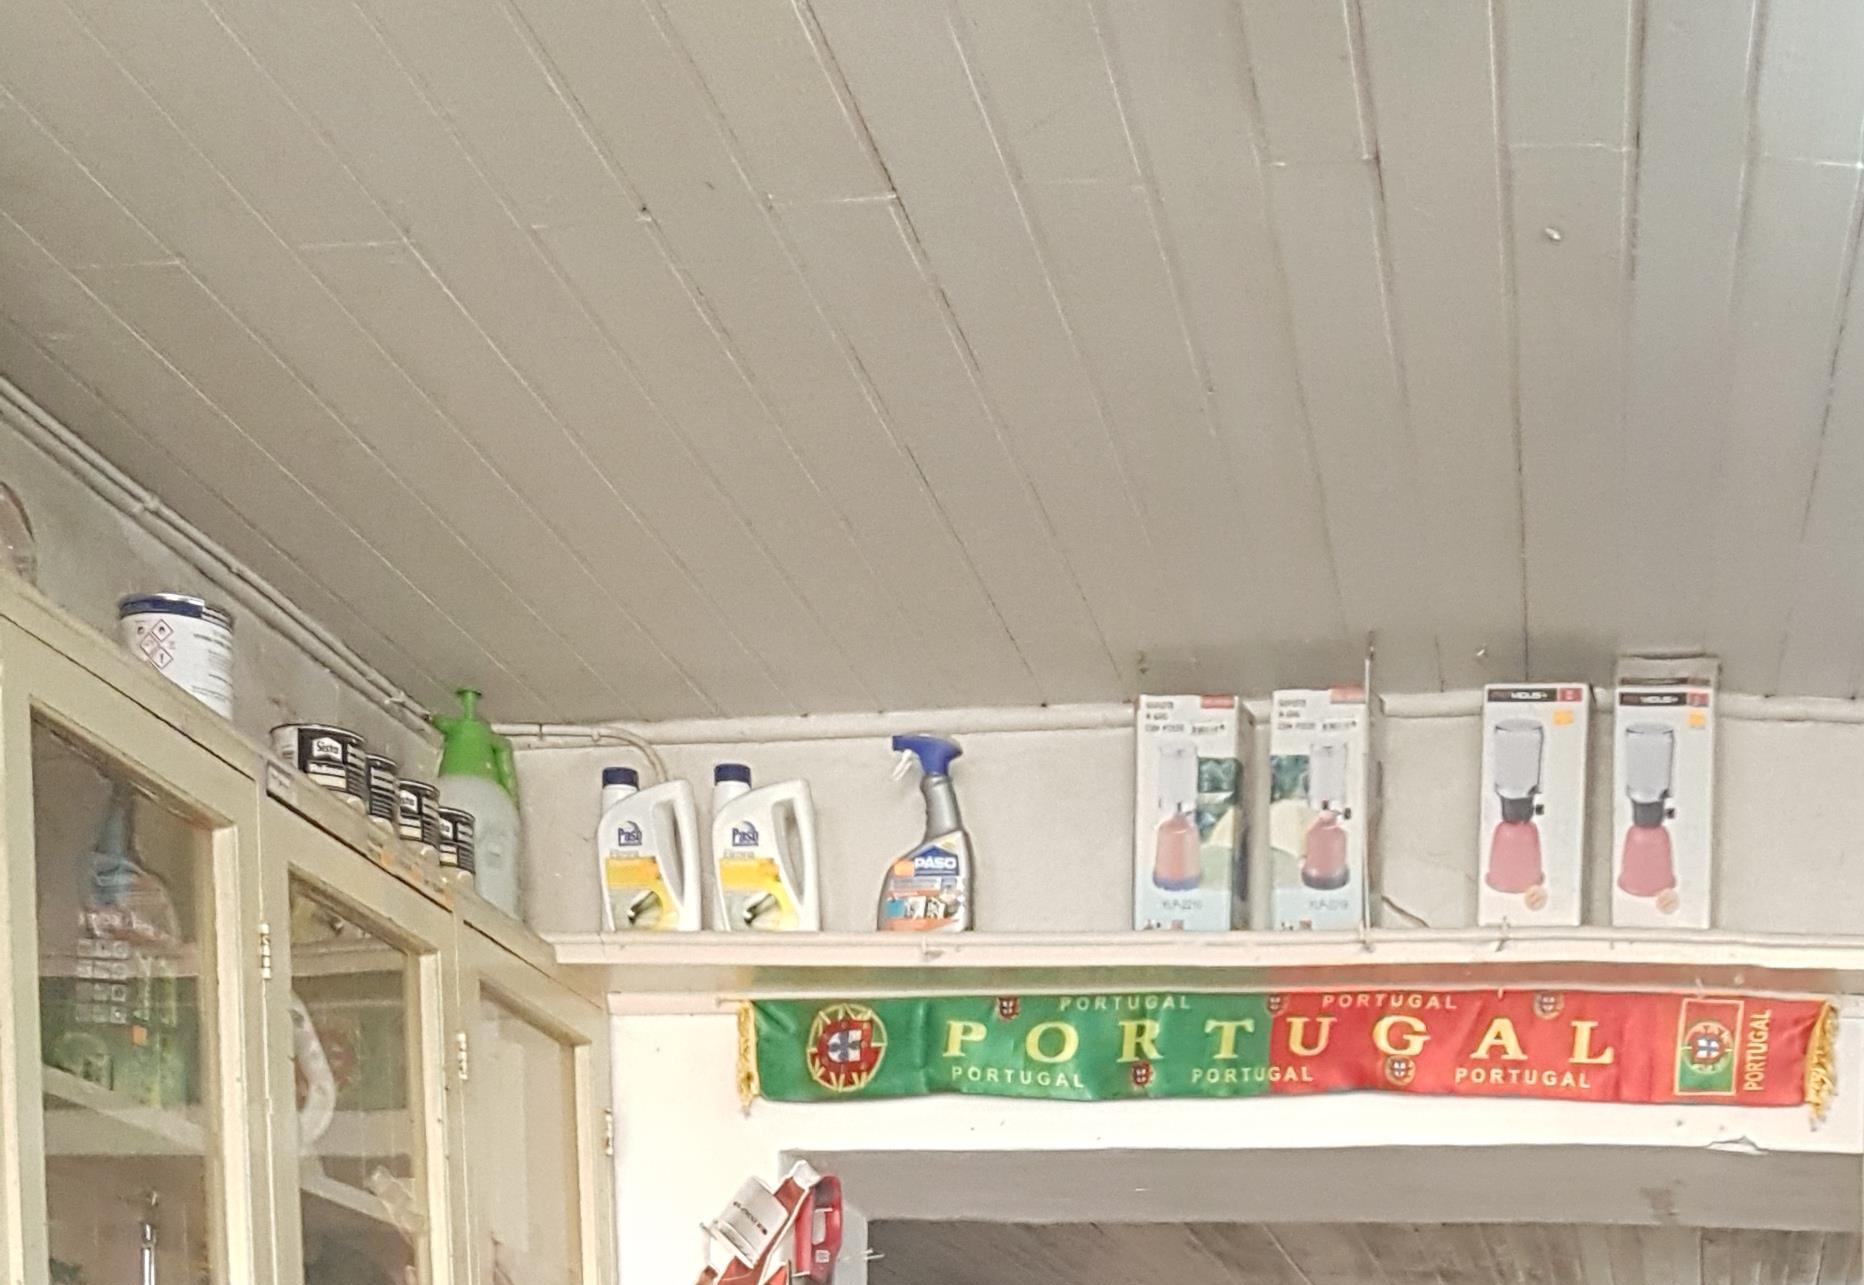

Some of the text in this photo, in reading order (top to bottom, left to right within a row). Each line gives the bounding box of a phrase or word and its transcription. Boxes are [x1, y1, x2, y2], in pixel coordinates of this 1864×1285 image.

[913, 856, 957, 870] PASO
[1060, 995, 1191, 1012] PORTUGAL
[1321, 993, 1458, 1010] PORTUGAL
[942, 1013, 1614, 1065] PORTUGAL
[1743, 1008, 1770, 1093] PORTUGAL
[951, 1066, 1085, 1089] PORTUGAL
[1191, 1065, 1314, 1084] PORTUGAL
[1455, 1067, 1591, 1089] PORTUGAL
